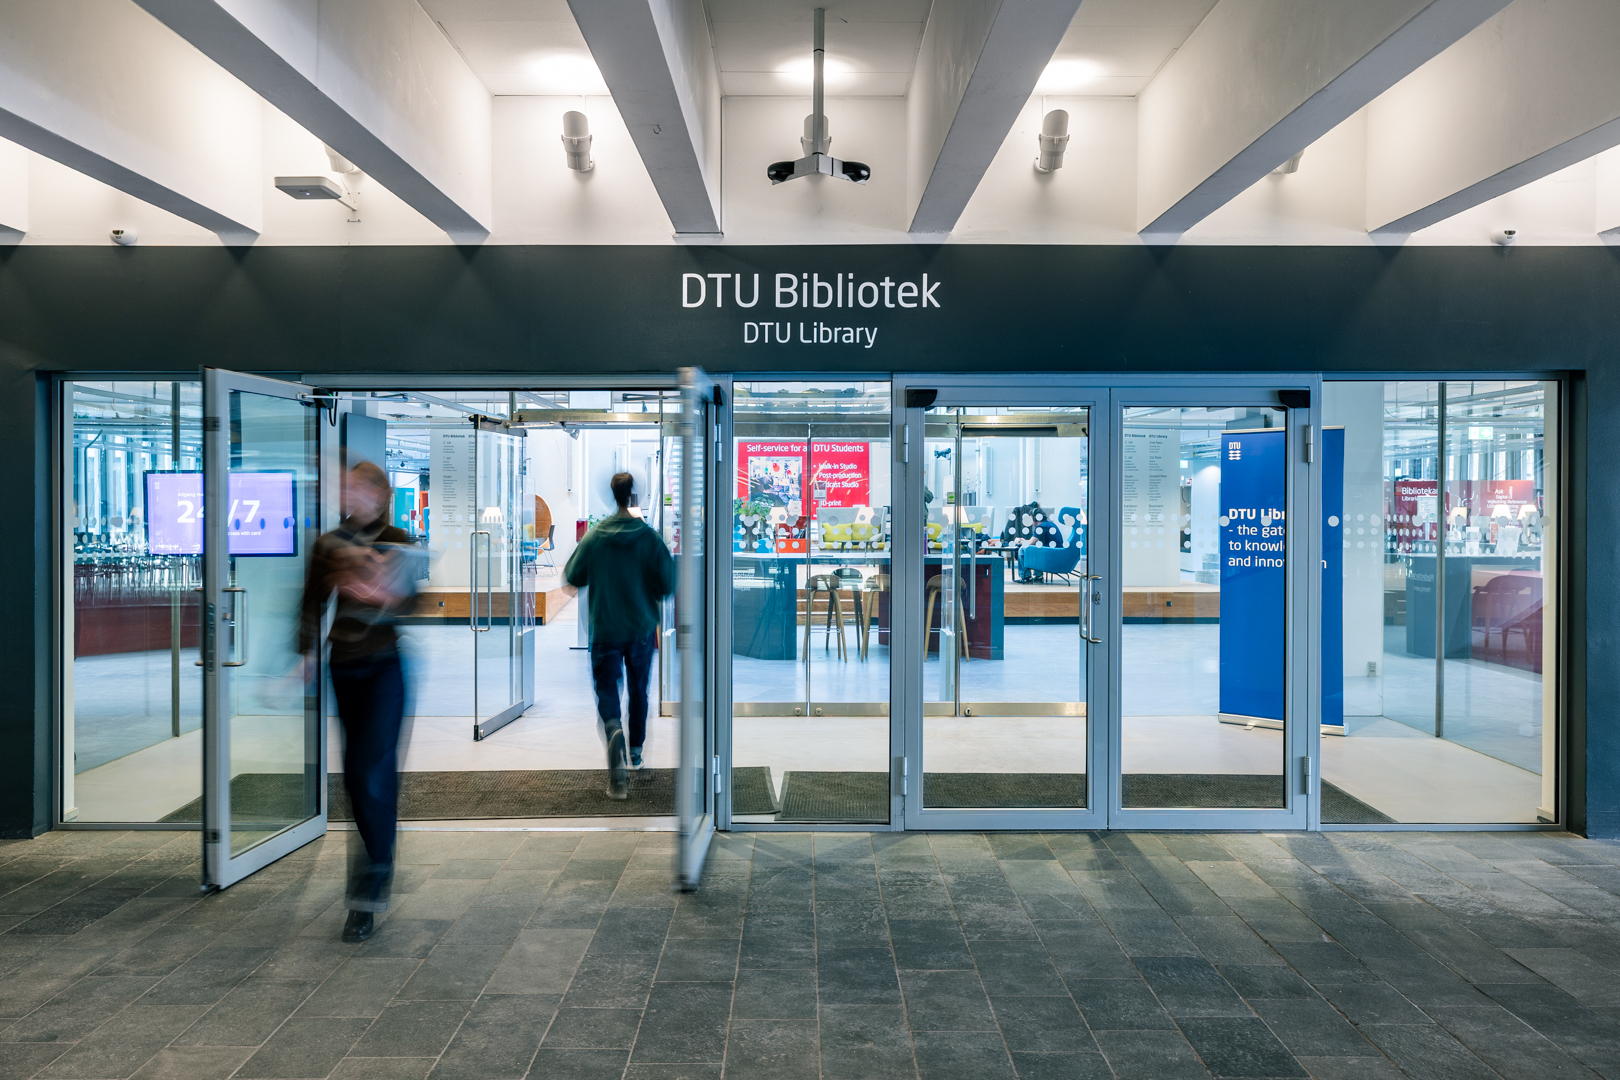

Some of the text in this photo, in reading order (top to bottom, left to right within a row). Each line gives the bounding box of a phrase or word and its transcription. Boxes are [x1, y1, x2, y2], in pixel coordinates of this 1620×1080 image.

[682, 272, 941, 308] DTU Bibliotek
[744, 322, 878, 348] DTU Library
[747, 444, 789, 452] Self-service
[790, 444, 802, 452] for
[814, 444, 830, 452] DTU
[831, 444, 864, 453] Students
[177, 499, 260, 527] 2/7
[1228, 508, 1256, 520] DTU
[1237, 524, 1258, 536] the
[1261, 526, 1285, 538] gat
[1228, 539, 1285, 552] to knowl
[1228, 556, 1251, 567] and
